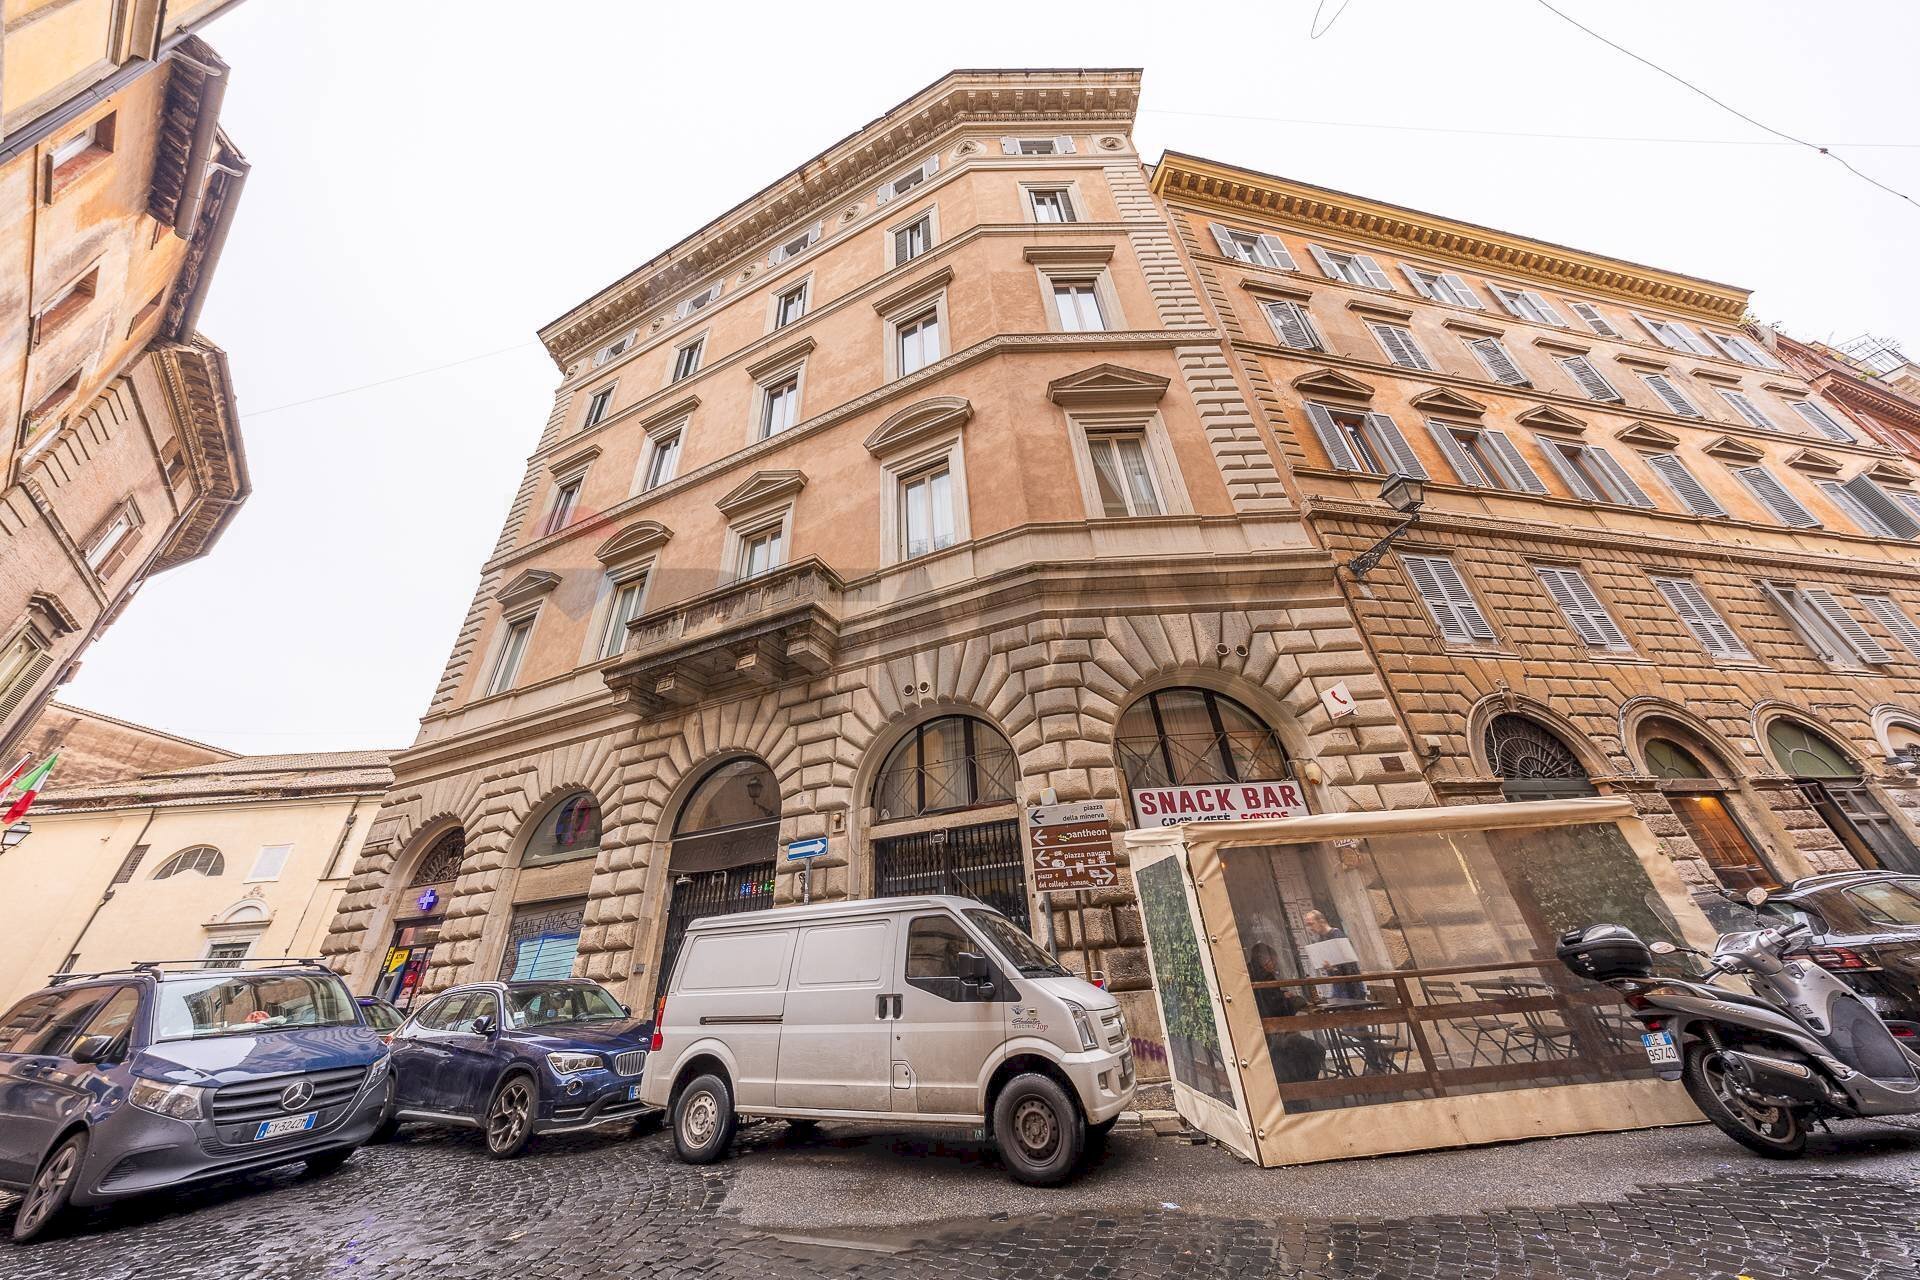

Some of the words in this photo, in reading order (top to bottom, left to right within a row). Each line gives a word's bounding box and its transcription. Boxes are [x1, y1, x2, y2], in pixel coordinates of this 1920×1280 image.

[1138, 788, 1237, 815] SNACK
[1241, 785, 1302, 809] BAR
[1064, 851, 1085, 860] piazza
[1048, 880, 1068, 888] collegio
[1648, 1047, 1676, 1061] 95740
